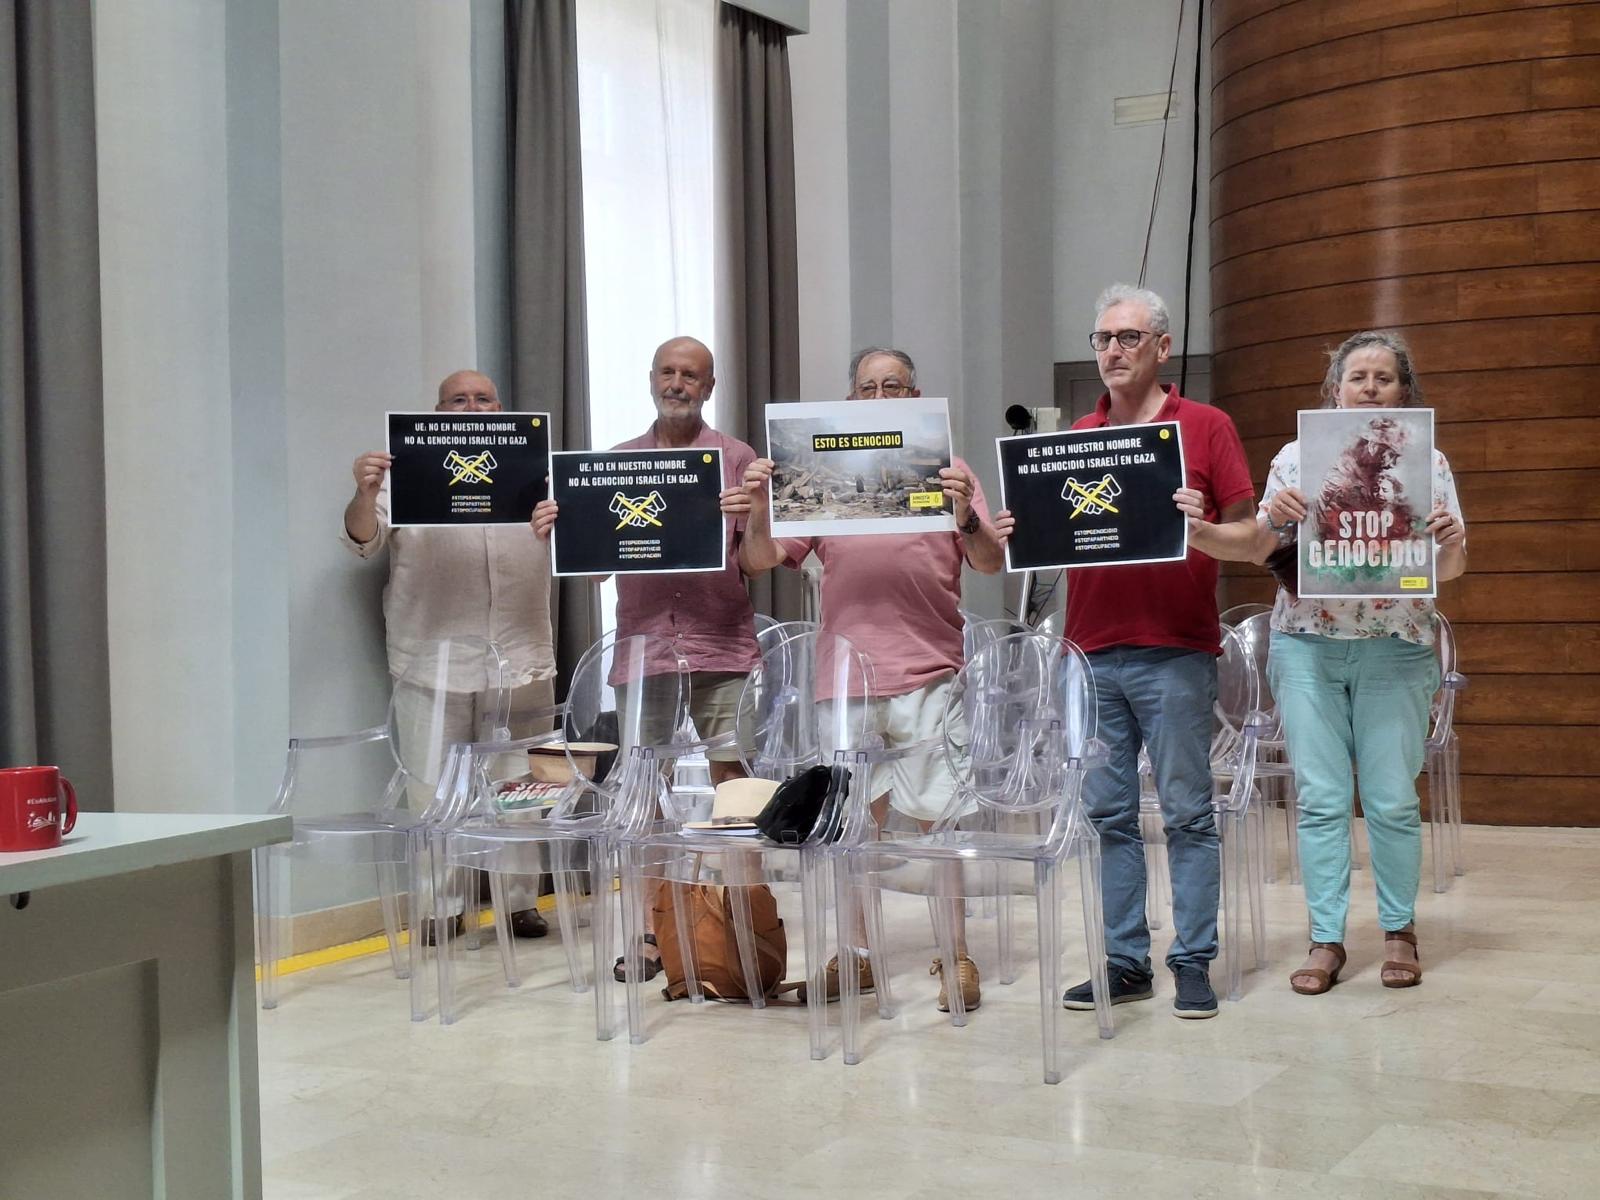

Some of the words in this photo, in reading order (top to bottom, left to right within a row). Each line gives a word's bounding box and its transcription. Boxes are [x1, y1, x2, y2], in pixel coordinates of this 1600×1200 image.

[415, 423, 427, 431] UE:
[429, 423, 438, 431] NO
[441, 423, 450, 431] EN
[452, 423, 485, 431] NUESTRO
[487, 423, 516, 431] NOMBRE
[405, 436, 414, 445] NO
[417, 436, 425, 445] AL
[428, 436, 466, 445] GENOCIDIO
[469, 434, 495, 445] ISRAELÍ
[498, 436, 507, 445] EN
[509, 436, 527, 445] GAZA
[815, 437, 836, 448] ESTO
[839, 437, 850, 447] ES
[852, 435, 901, 447] GENOCIDIO
[1028, 448, 1040, 458] UE:
[1042, 447, 1053, 457] NO
[1055, 446, 1065, 455] EN
[1068, 441, 1104, 454] NUESTRO
[1106, 438, 1141, 450] NOMBRE
[580, 463, 592, 472] UE:
[594, 463, 603, 471] NO
[606, 462, 616, 471] EN
[618, 461, 652, 471] NUESTRO
[654, 460, 686, 469] NOMBRE
[1018, 465, 1028, 475] NO
[1030, 464, 1040, 474] AL
[1042, 460, 1085, 472] GENOCIDIO
[1087, 456, 1118, 469] ISRAELÍ
[1121, 455, 1132, 465] EN
[1134, 453, 1156, 464] GAZA
[569, 478, 579, 486] NO
[581, 477, 590, 486] AL
[592, 476, 633, 486] GENOCIDIO
[636, 473, 664, 484] ISRAELÍ
[667, 475, 677, 483] EN
[680, 474, 698, 483] GAZA
[1339, 511, 1394, 538] STOP
[1309, 540, 1426, 567] GENOCIDIO
